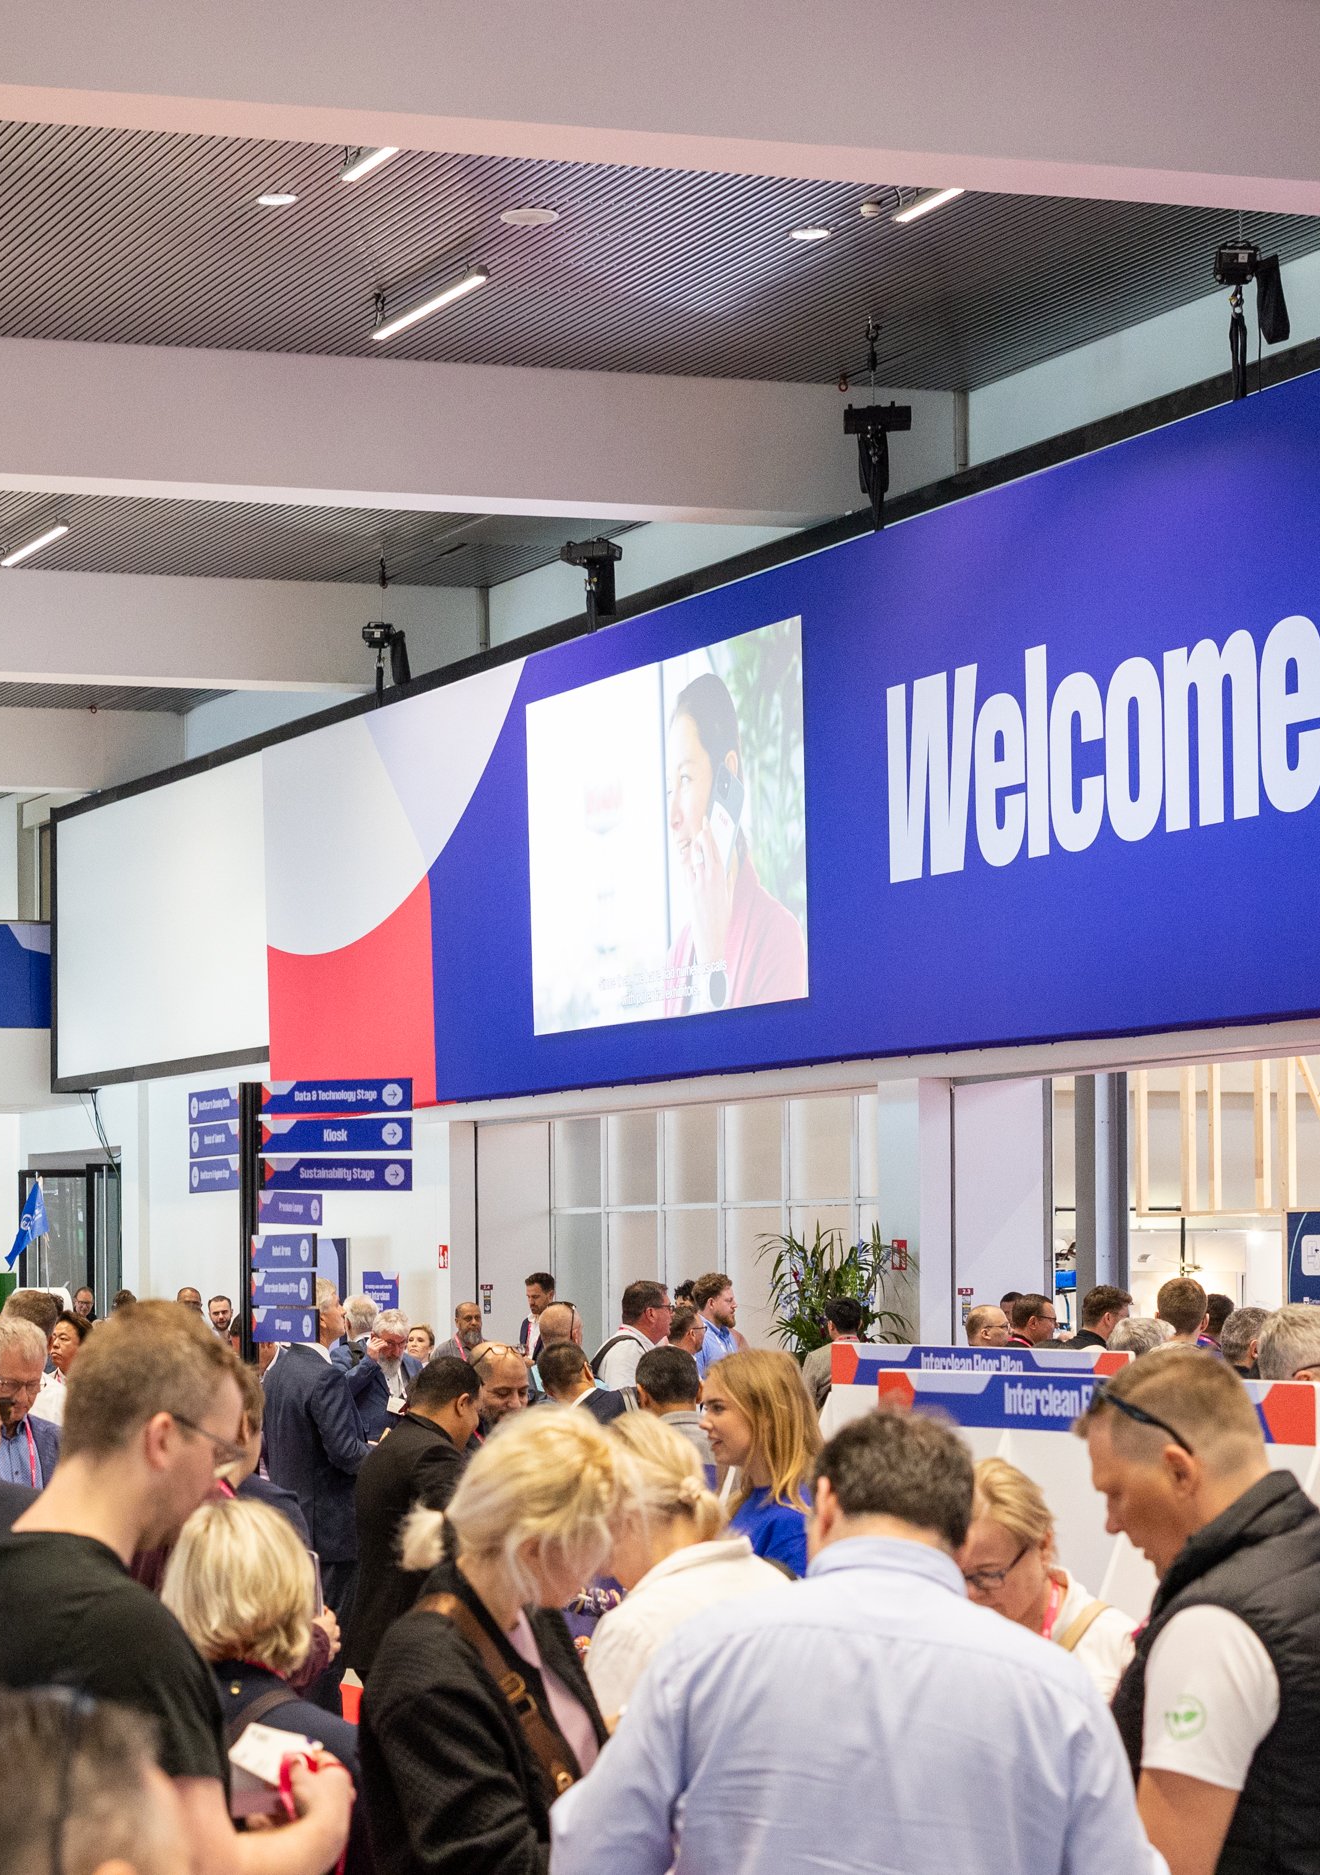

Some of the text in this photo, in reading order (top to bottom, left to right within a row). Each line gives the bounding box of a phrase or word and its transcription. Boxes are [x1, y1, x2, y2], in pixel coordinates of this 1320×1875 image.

[294, 1089, 377, 1102] Data & Technology Stage
[323, 1128, 348, 1142] Kiosk
[300, 1167, 375, 1182] Sustainability Stage
[920, 1352, 1024, 1373] Interclean Floor Plan
[1003, 1382, 1080, 1418] Interclean
